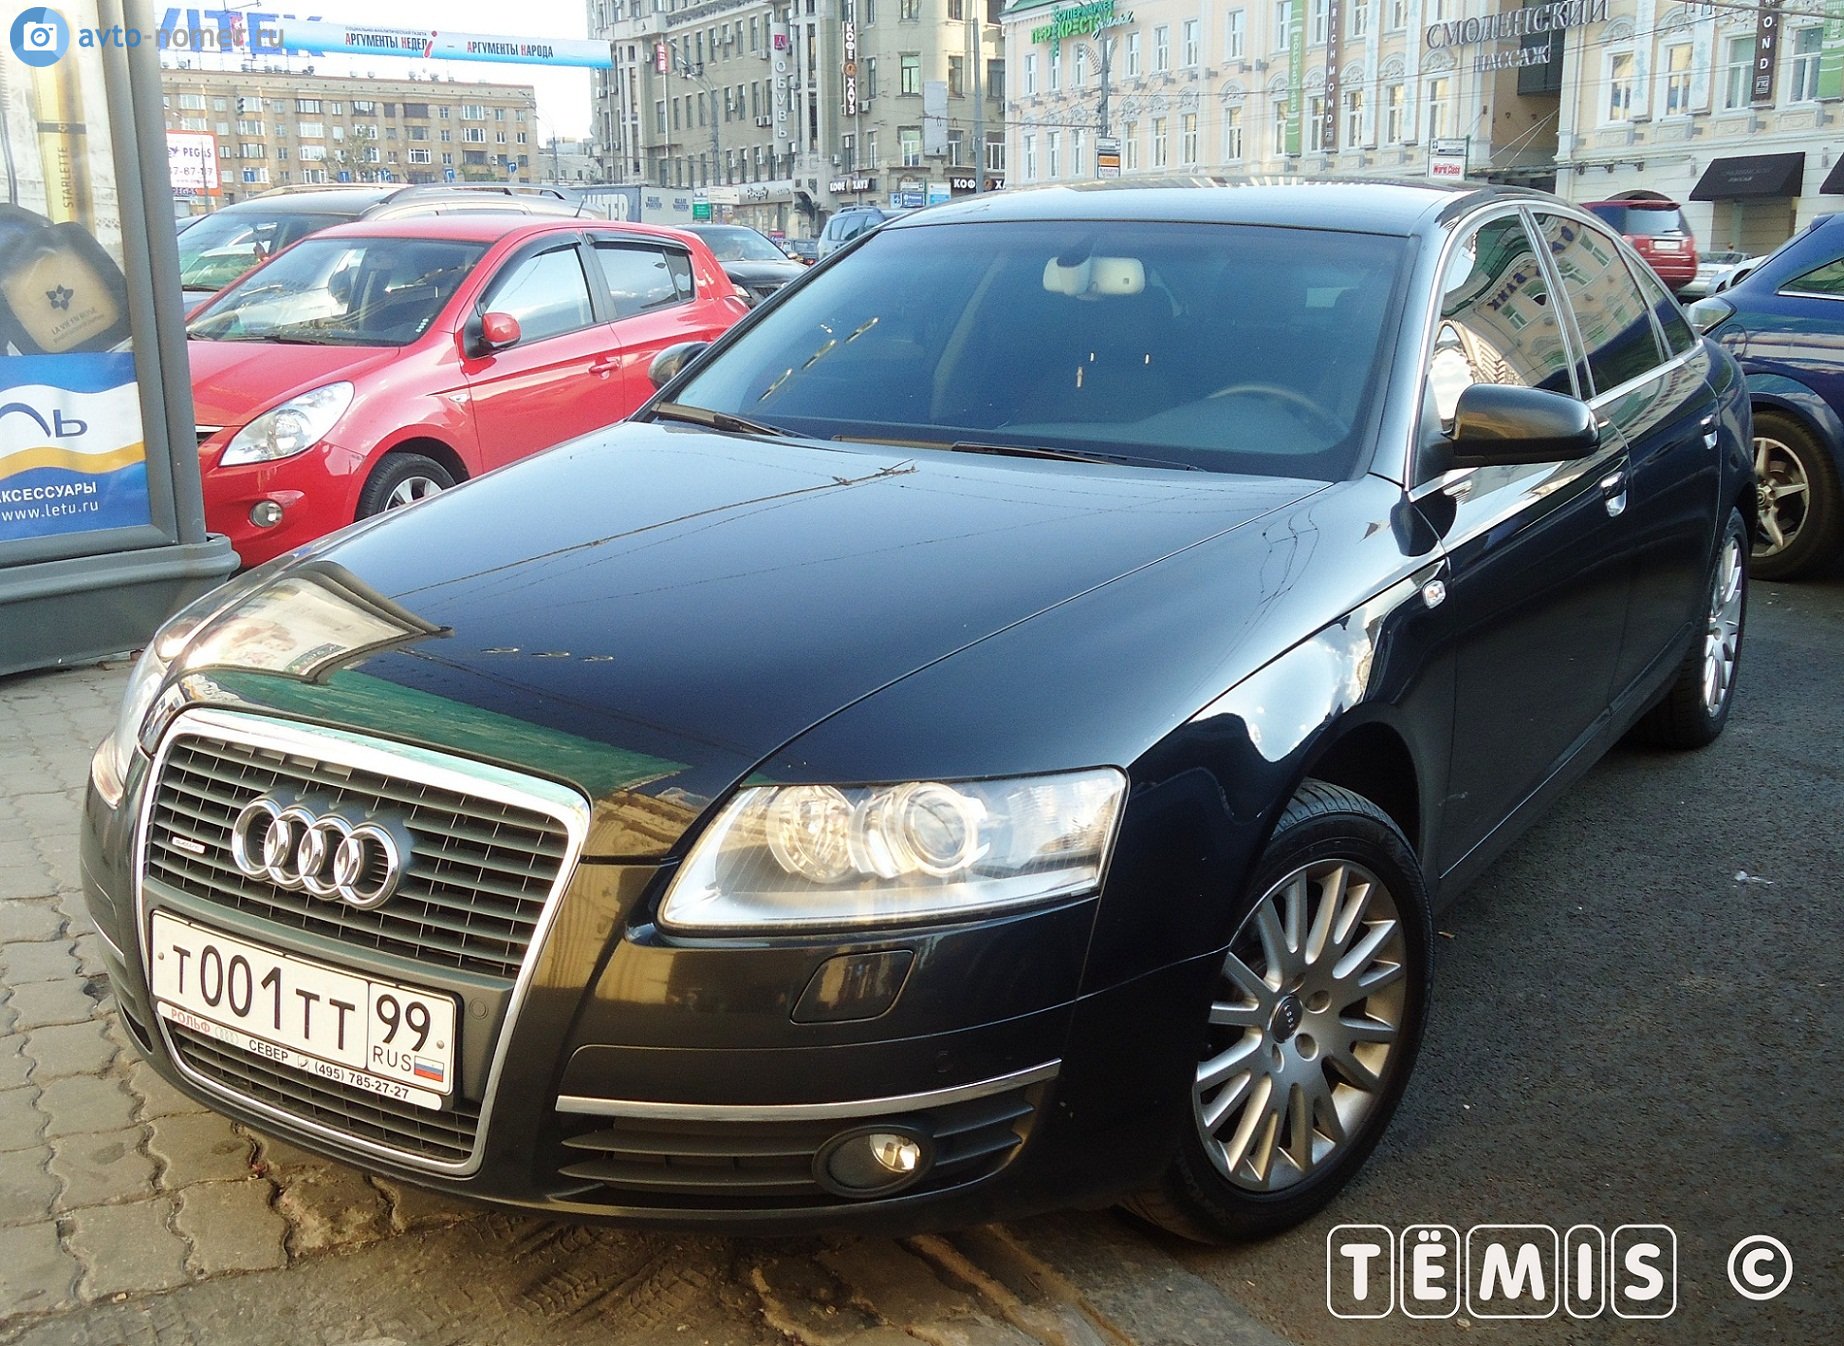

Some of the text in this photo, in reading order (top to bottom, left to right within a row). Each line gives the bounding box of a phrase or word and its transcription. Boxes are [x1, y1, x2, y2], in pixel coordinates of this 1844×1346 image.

[345, 32, 399, 49] АРГУМЕНТЫ
[467, 41, 519, 56] АРГУМЕНТЫ
[520, 44, 554, 59] НАРОДА
[845, 23, 856, 60] КОФЕ
[1327, 8, 1338, 124] RICHMOND
[1474, 45, 1550, 73] ПАССАЖ
[775, 60, 788, 138] ОБУВЬ
[57, 147, 74, 208] STARLETTE
[953, 178, 976, 189] КОФ
[0, 482, 97, 504] КСЕССУАРЫ
[2, 501, 98, 521] www.letu.ru
[173, 944, 431, 1052] Т001ТТ 99
[171, 1008, 211, 1034] РОЛЬФ
[249, 1039, 410, 1100] СЕВЕР (495) 785-27-27
[373, 1045, 412, 1072] RUS
